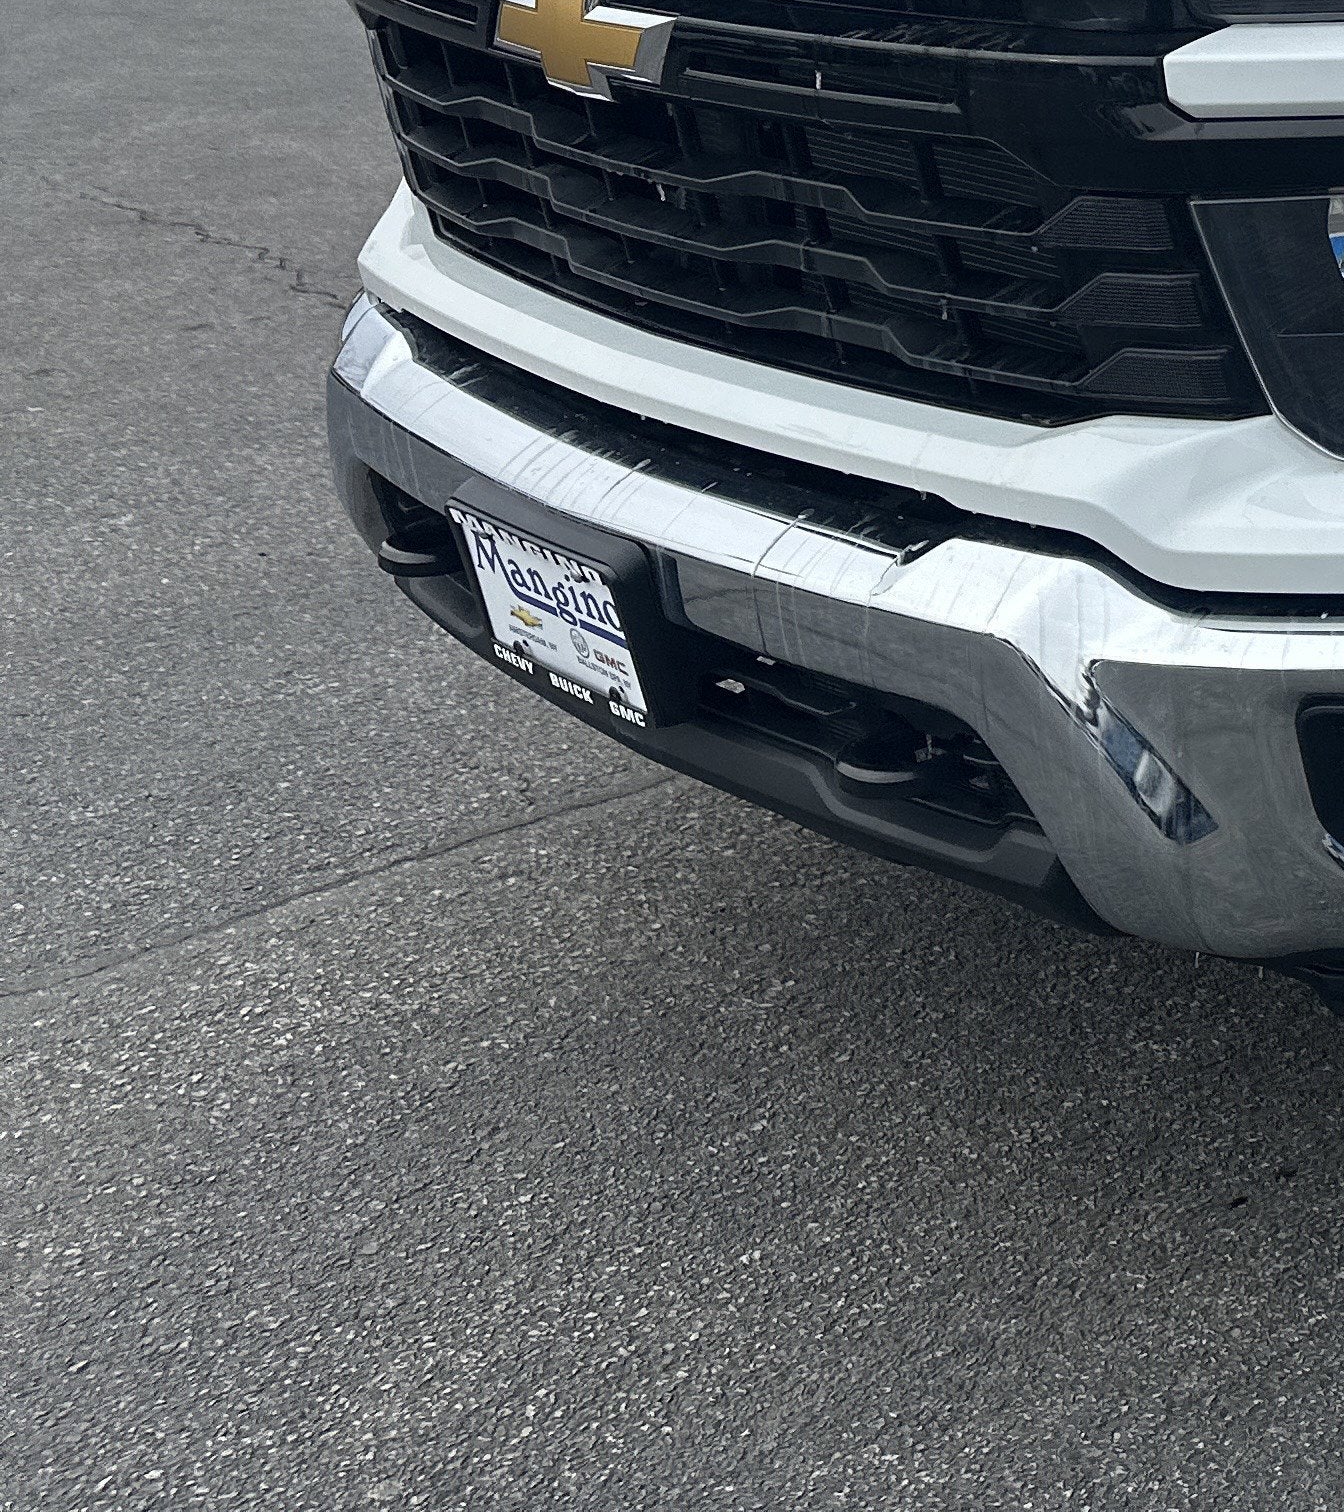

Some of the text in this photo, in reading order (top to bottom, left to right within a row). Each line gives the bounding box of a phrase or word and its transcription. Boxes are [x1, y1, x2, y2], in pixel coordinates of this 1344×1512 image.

[470, 529, 622, 632] Mangino
[493, 643, 646, 727] CHEVY BUICK GMC
[593, 648, 629, 676] GMC
